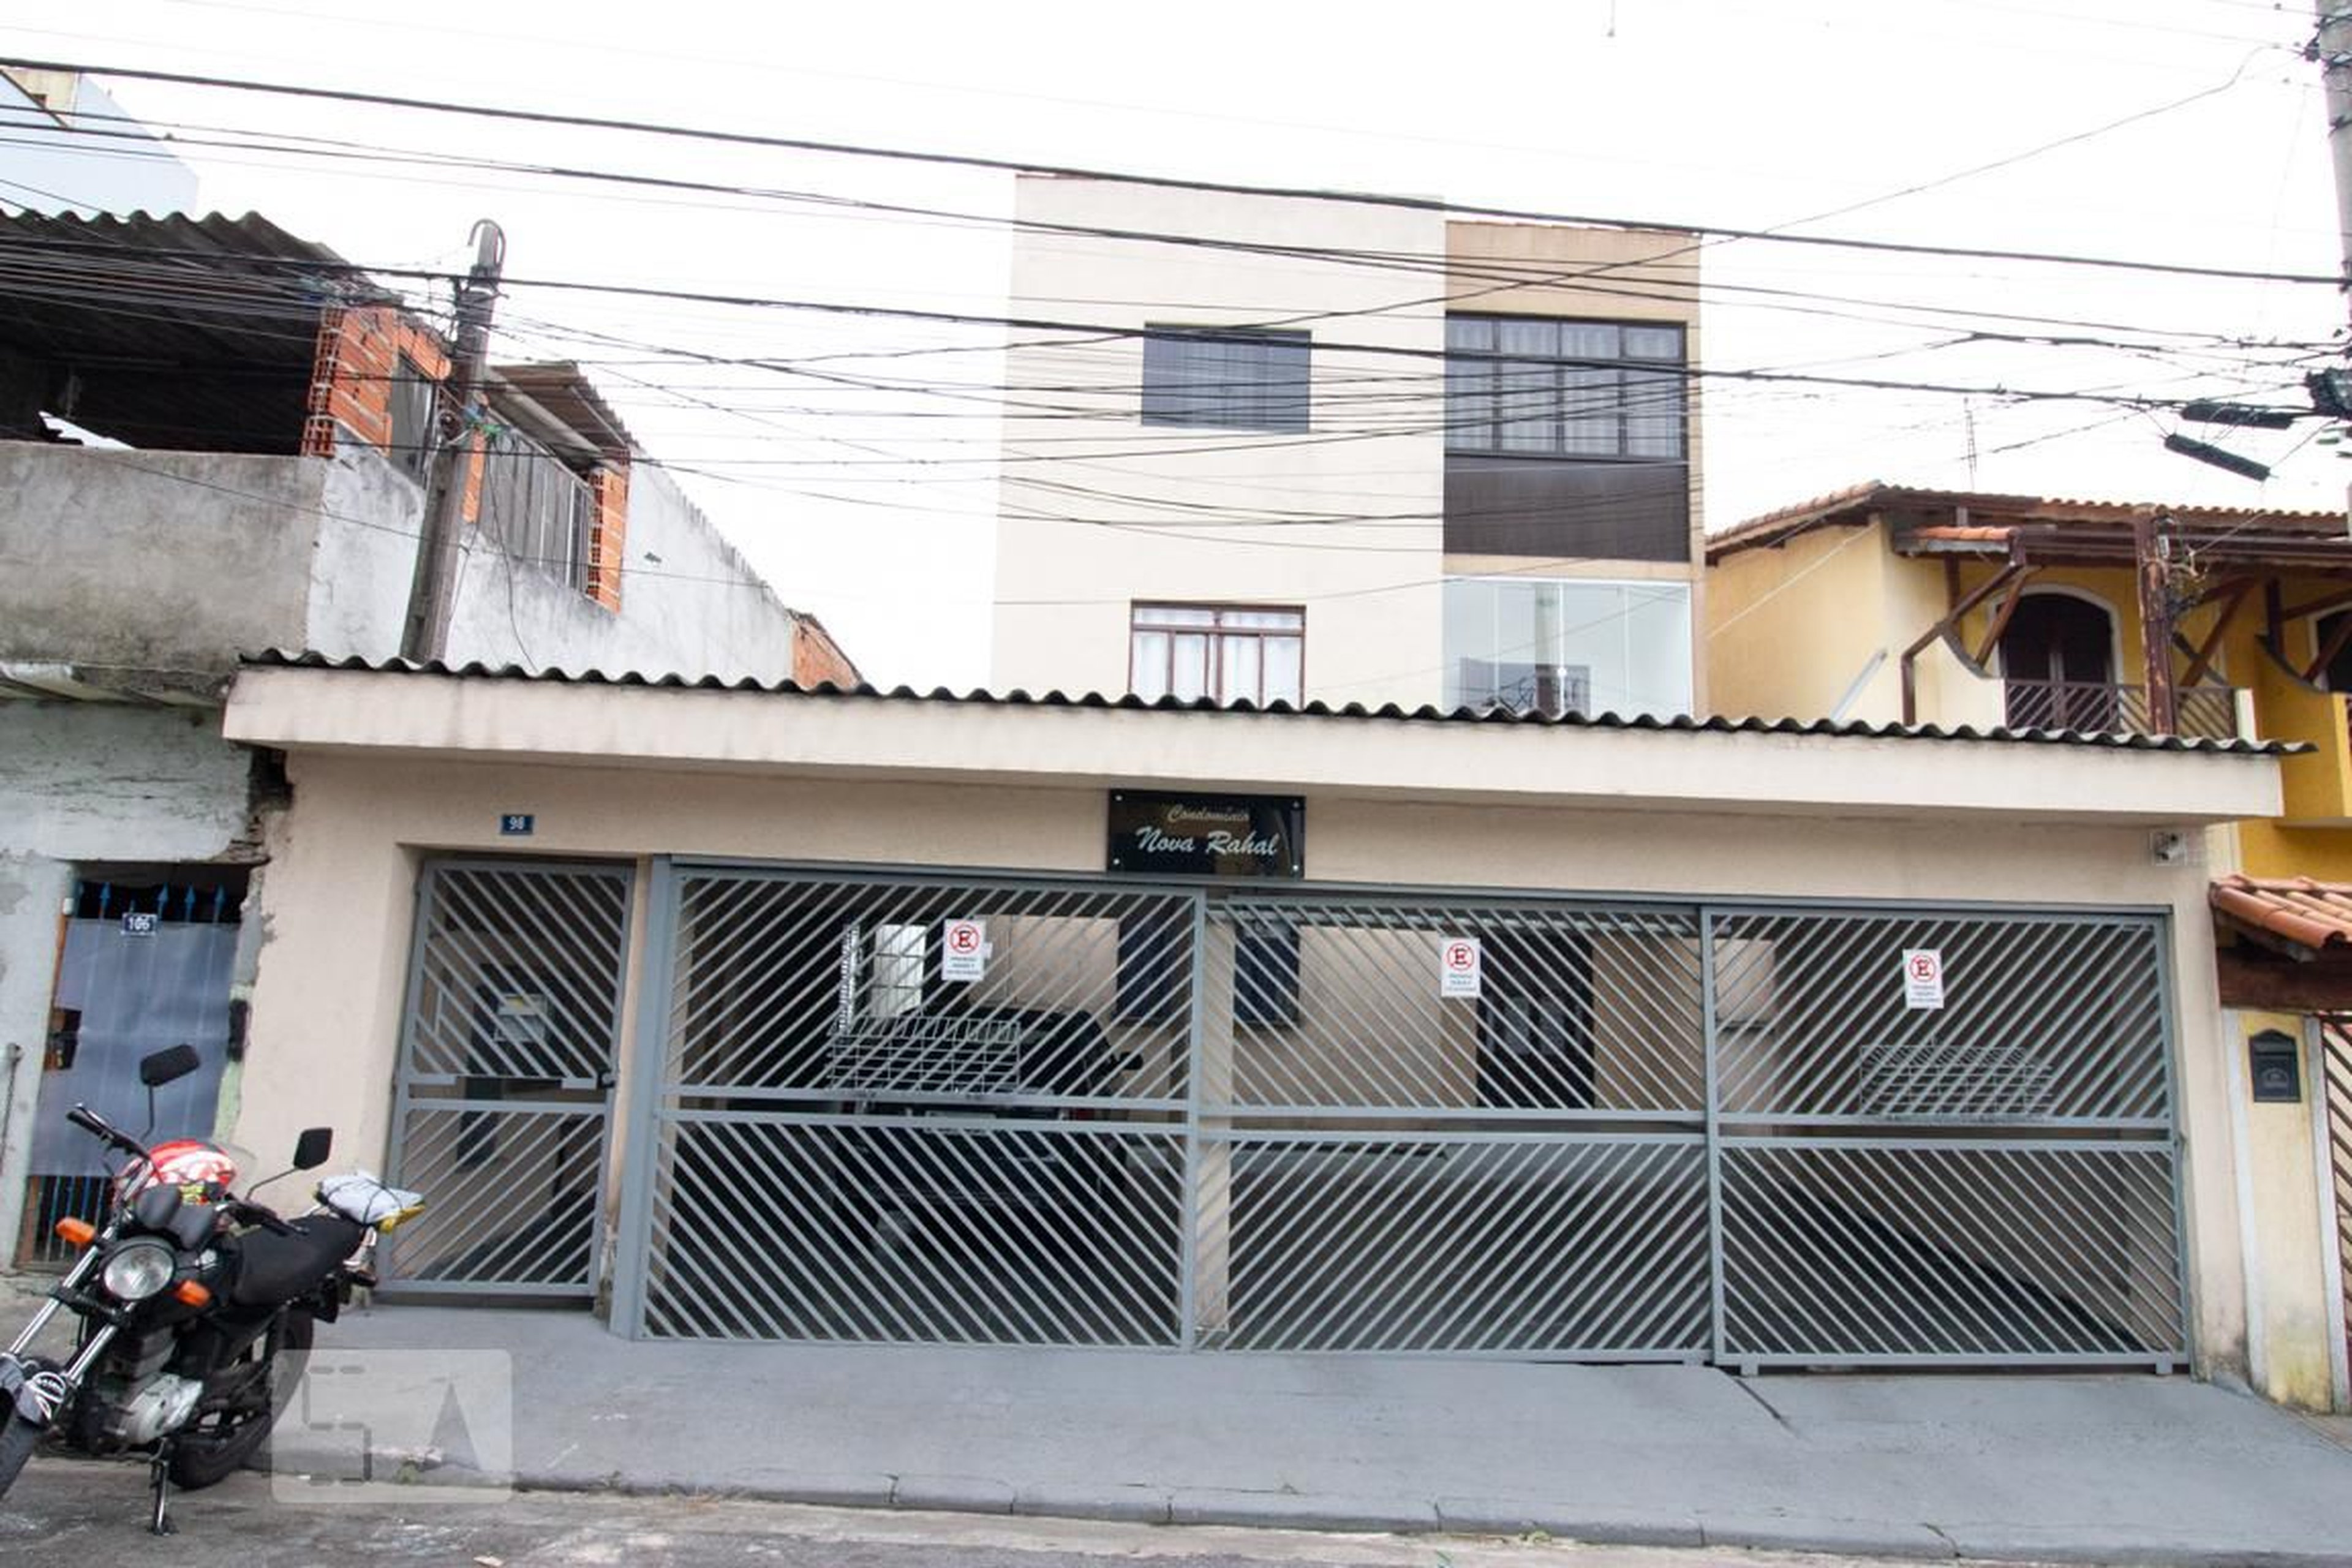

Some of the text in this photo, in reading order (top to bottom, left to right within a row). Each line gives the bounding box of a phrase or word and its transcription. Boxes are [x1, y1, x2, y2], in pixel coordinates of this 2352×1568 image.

[1136, 826, 1280, 856] Nova Rahal
[959, 930, 972, 948] E
[1454, 948, 1468, 965] E
[1917, 959, 1930, 976] E
